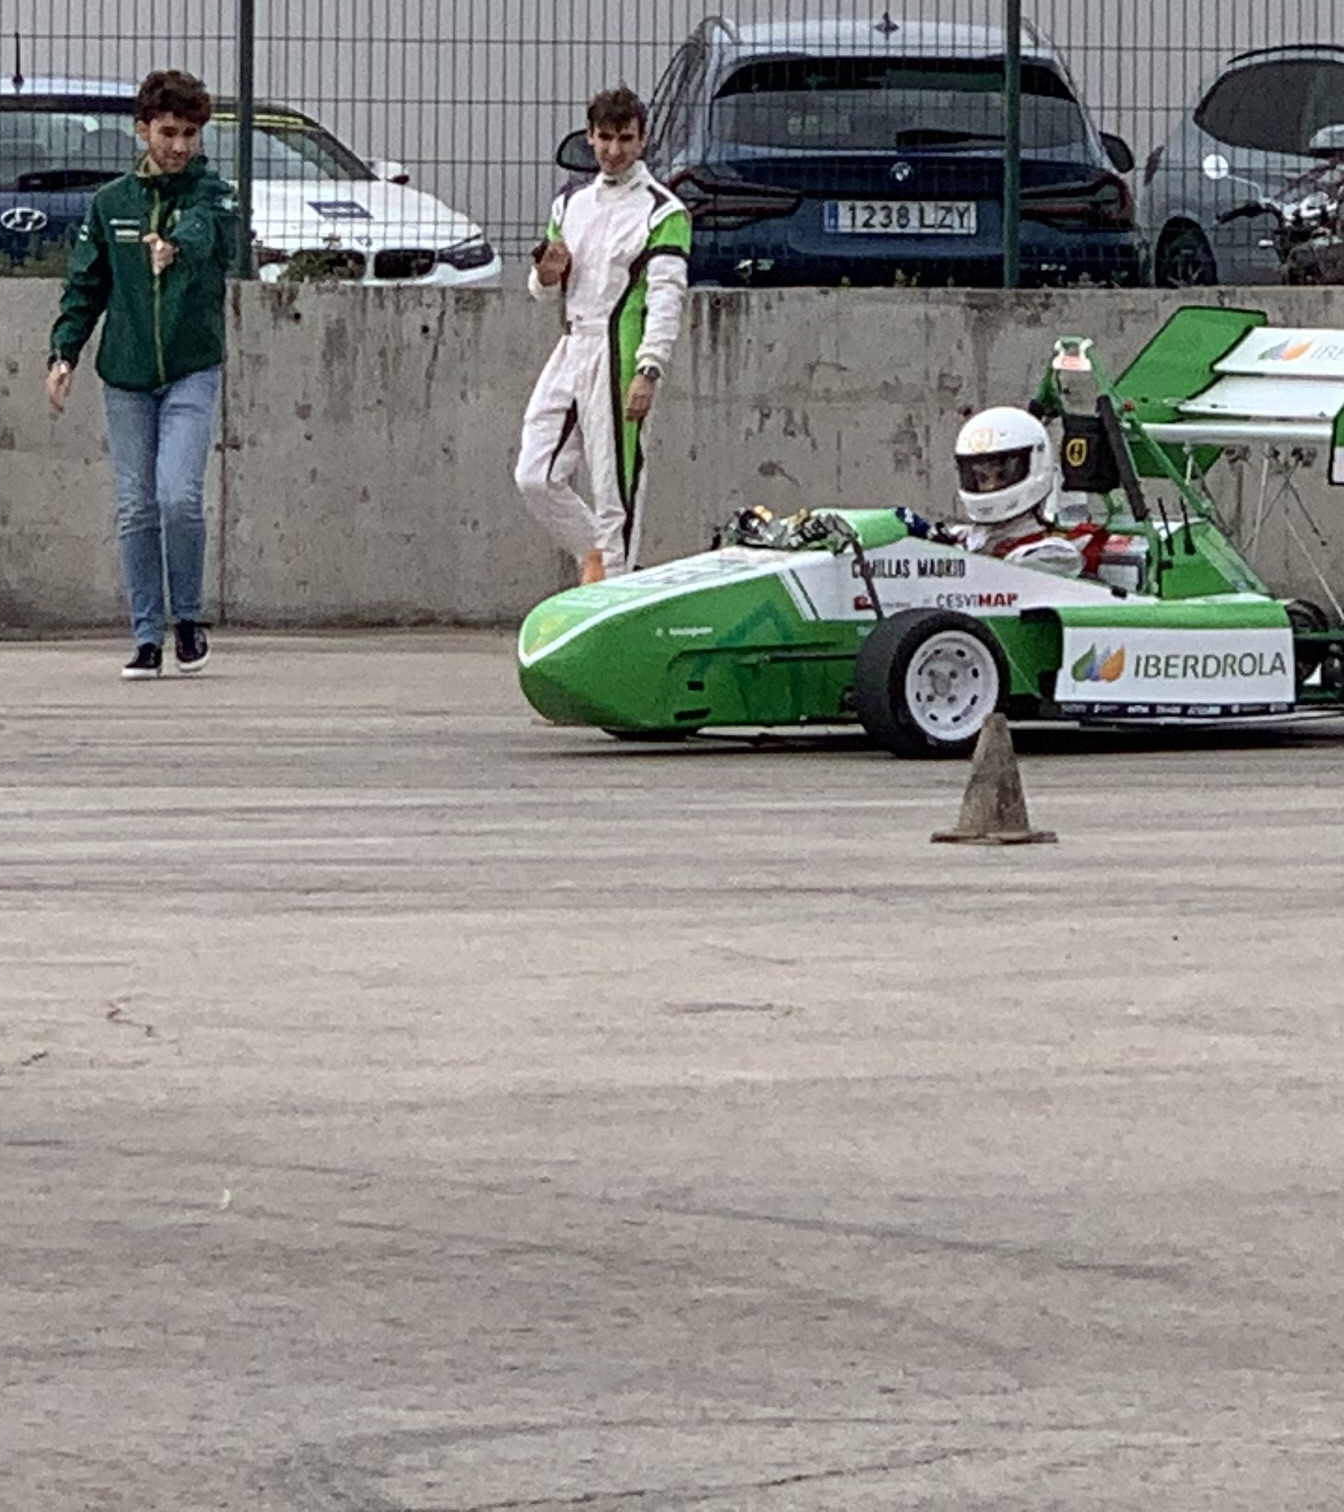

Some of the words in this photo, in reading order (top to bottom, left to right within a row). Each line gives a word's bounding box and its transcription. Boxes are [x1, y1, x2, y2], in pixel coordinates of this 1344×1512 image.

[848, 204, 911, 229] 1238
[918, 204, 972, 229] LZY
[917, 558, 966, 579] MADRID
[1134, 651, 1288, 679] IBERDROLA
